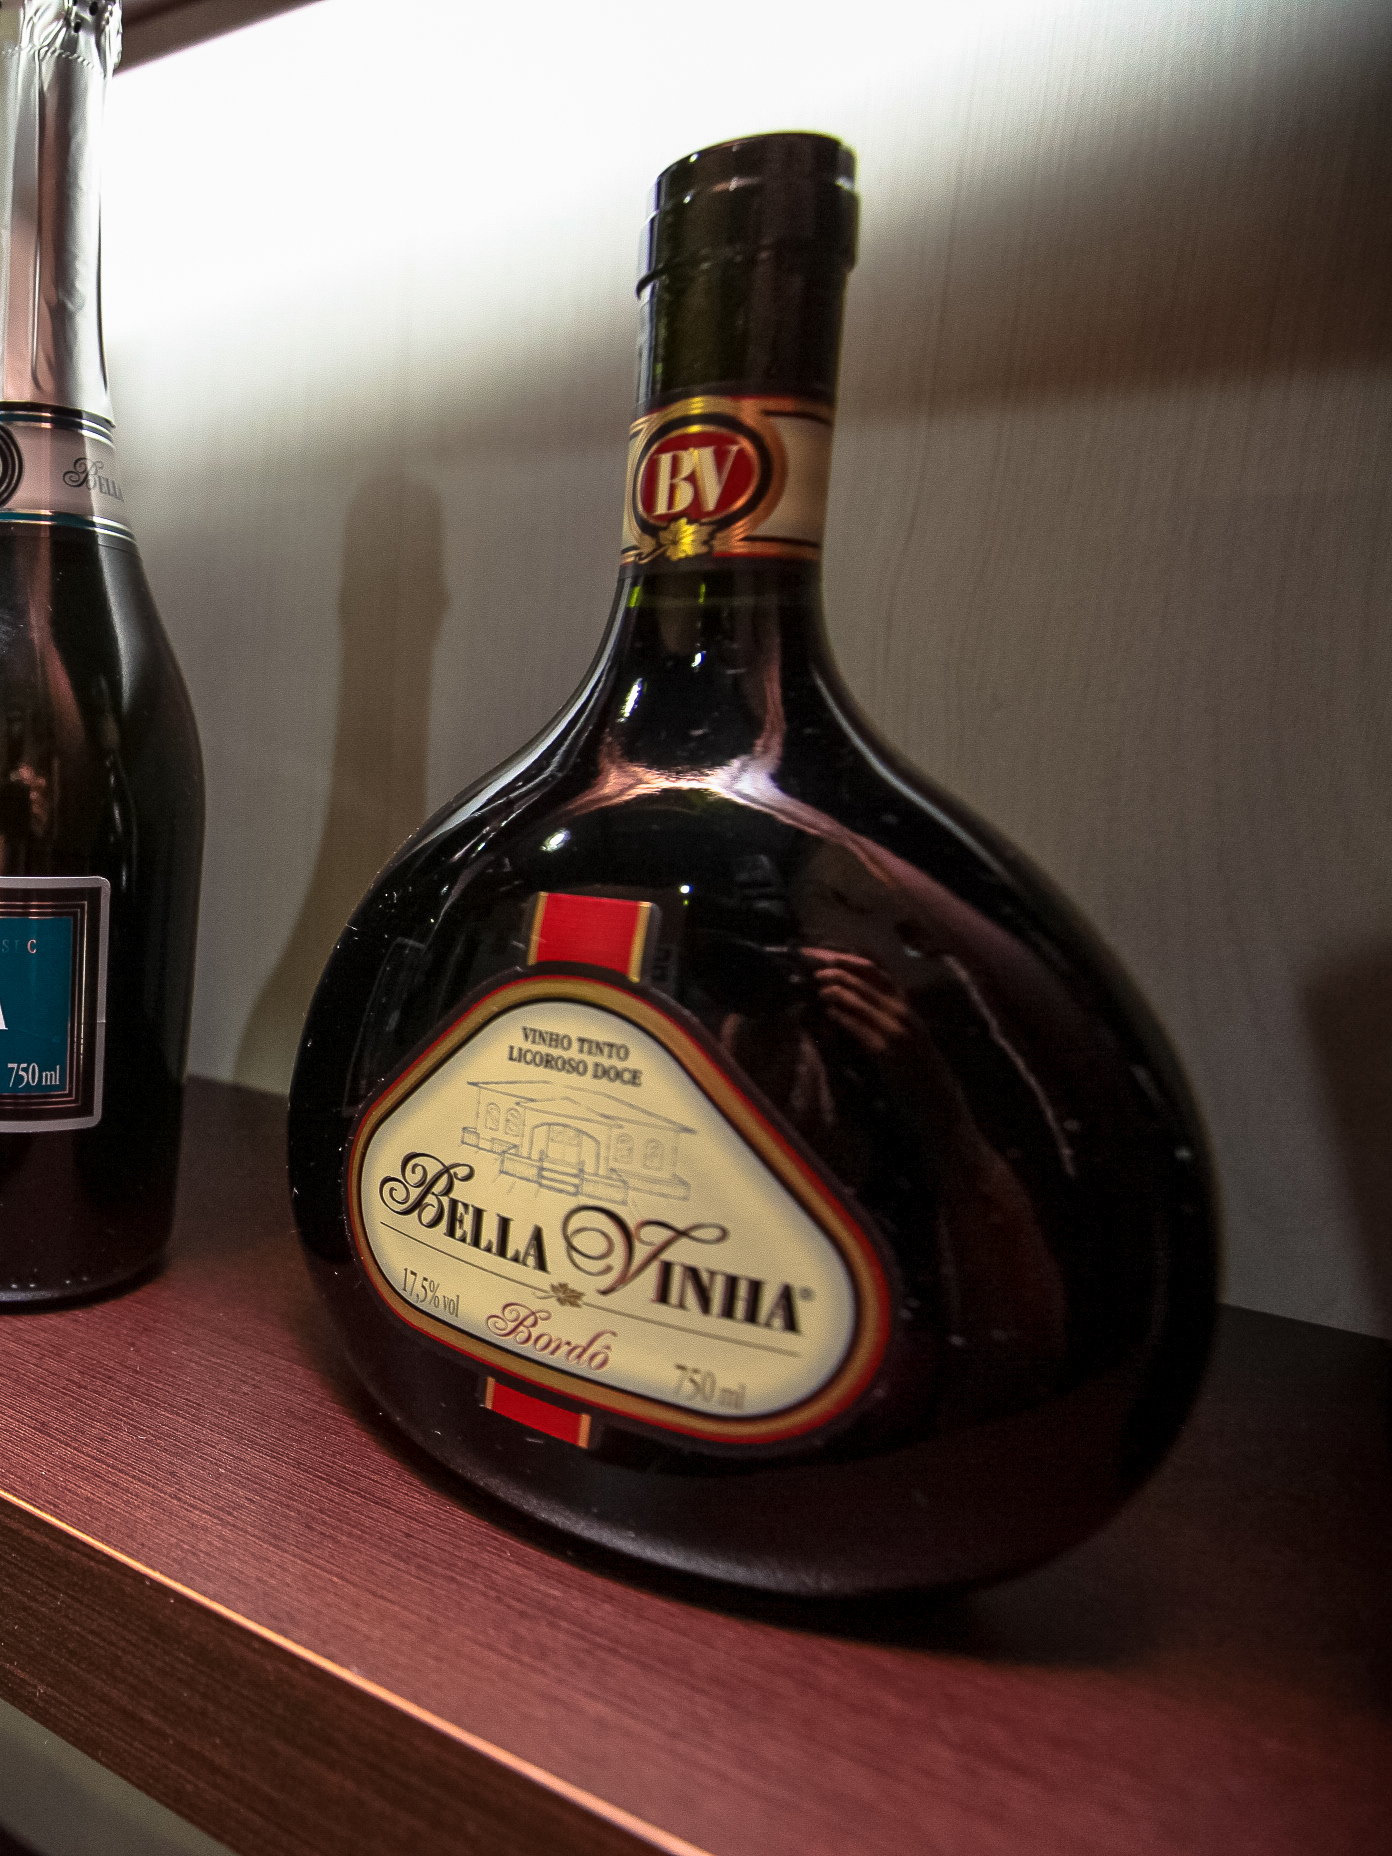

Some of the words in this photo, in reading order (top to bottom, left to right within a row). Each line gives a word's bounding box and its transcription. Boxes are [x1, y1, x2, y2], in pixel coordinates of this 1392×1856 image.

[651, 445, 743, 516] BV
[508, 1045, 588, 1077] LICOROSO
[592, 1061, 643, 1087] DOCE
[522, 1026, 573, 1051] VINHO
[577, 1036, 630, 1062] TINTO
[379, 1151, 550, 1274] BELLA
[402, 1267, 440, 1308] 17,5%
[442, 1294, 460, 1317] vol
[675, 1363, 716, 1403] 750
[718, 1384, 747, 1409] ml
